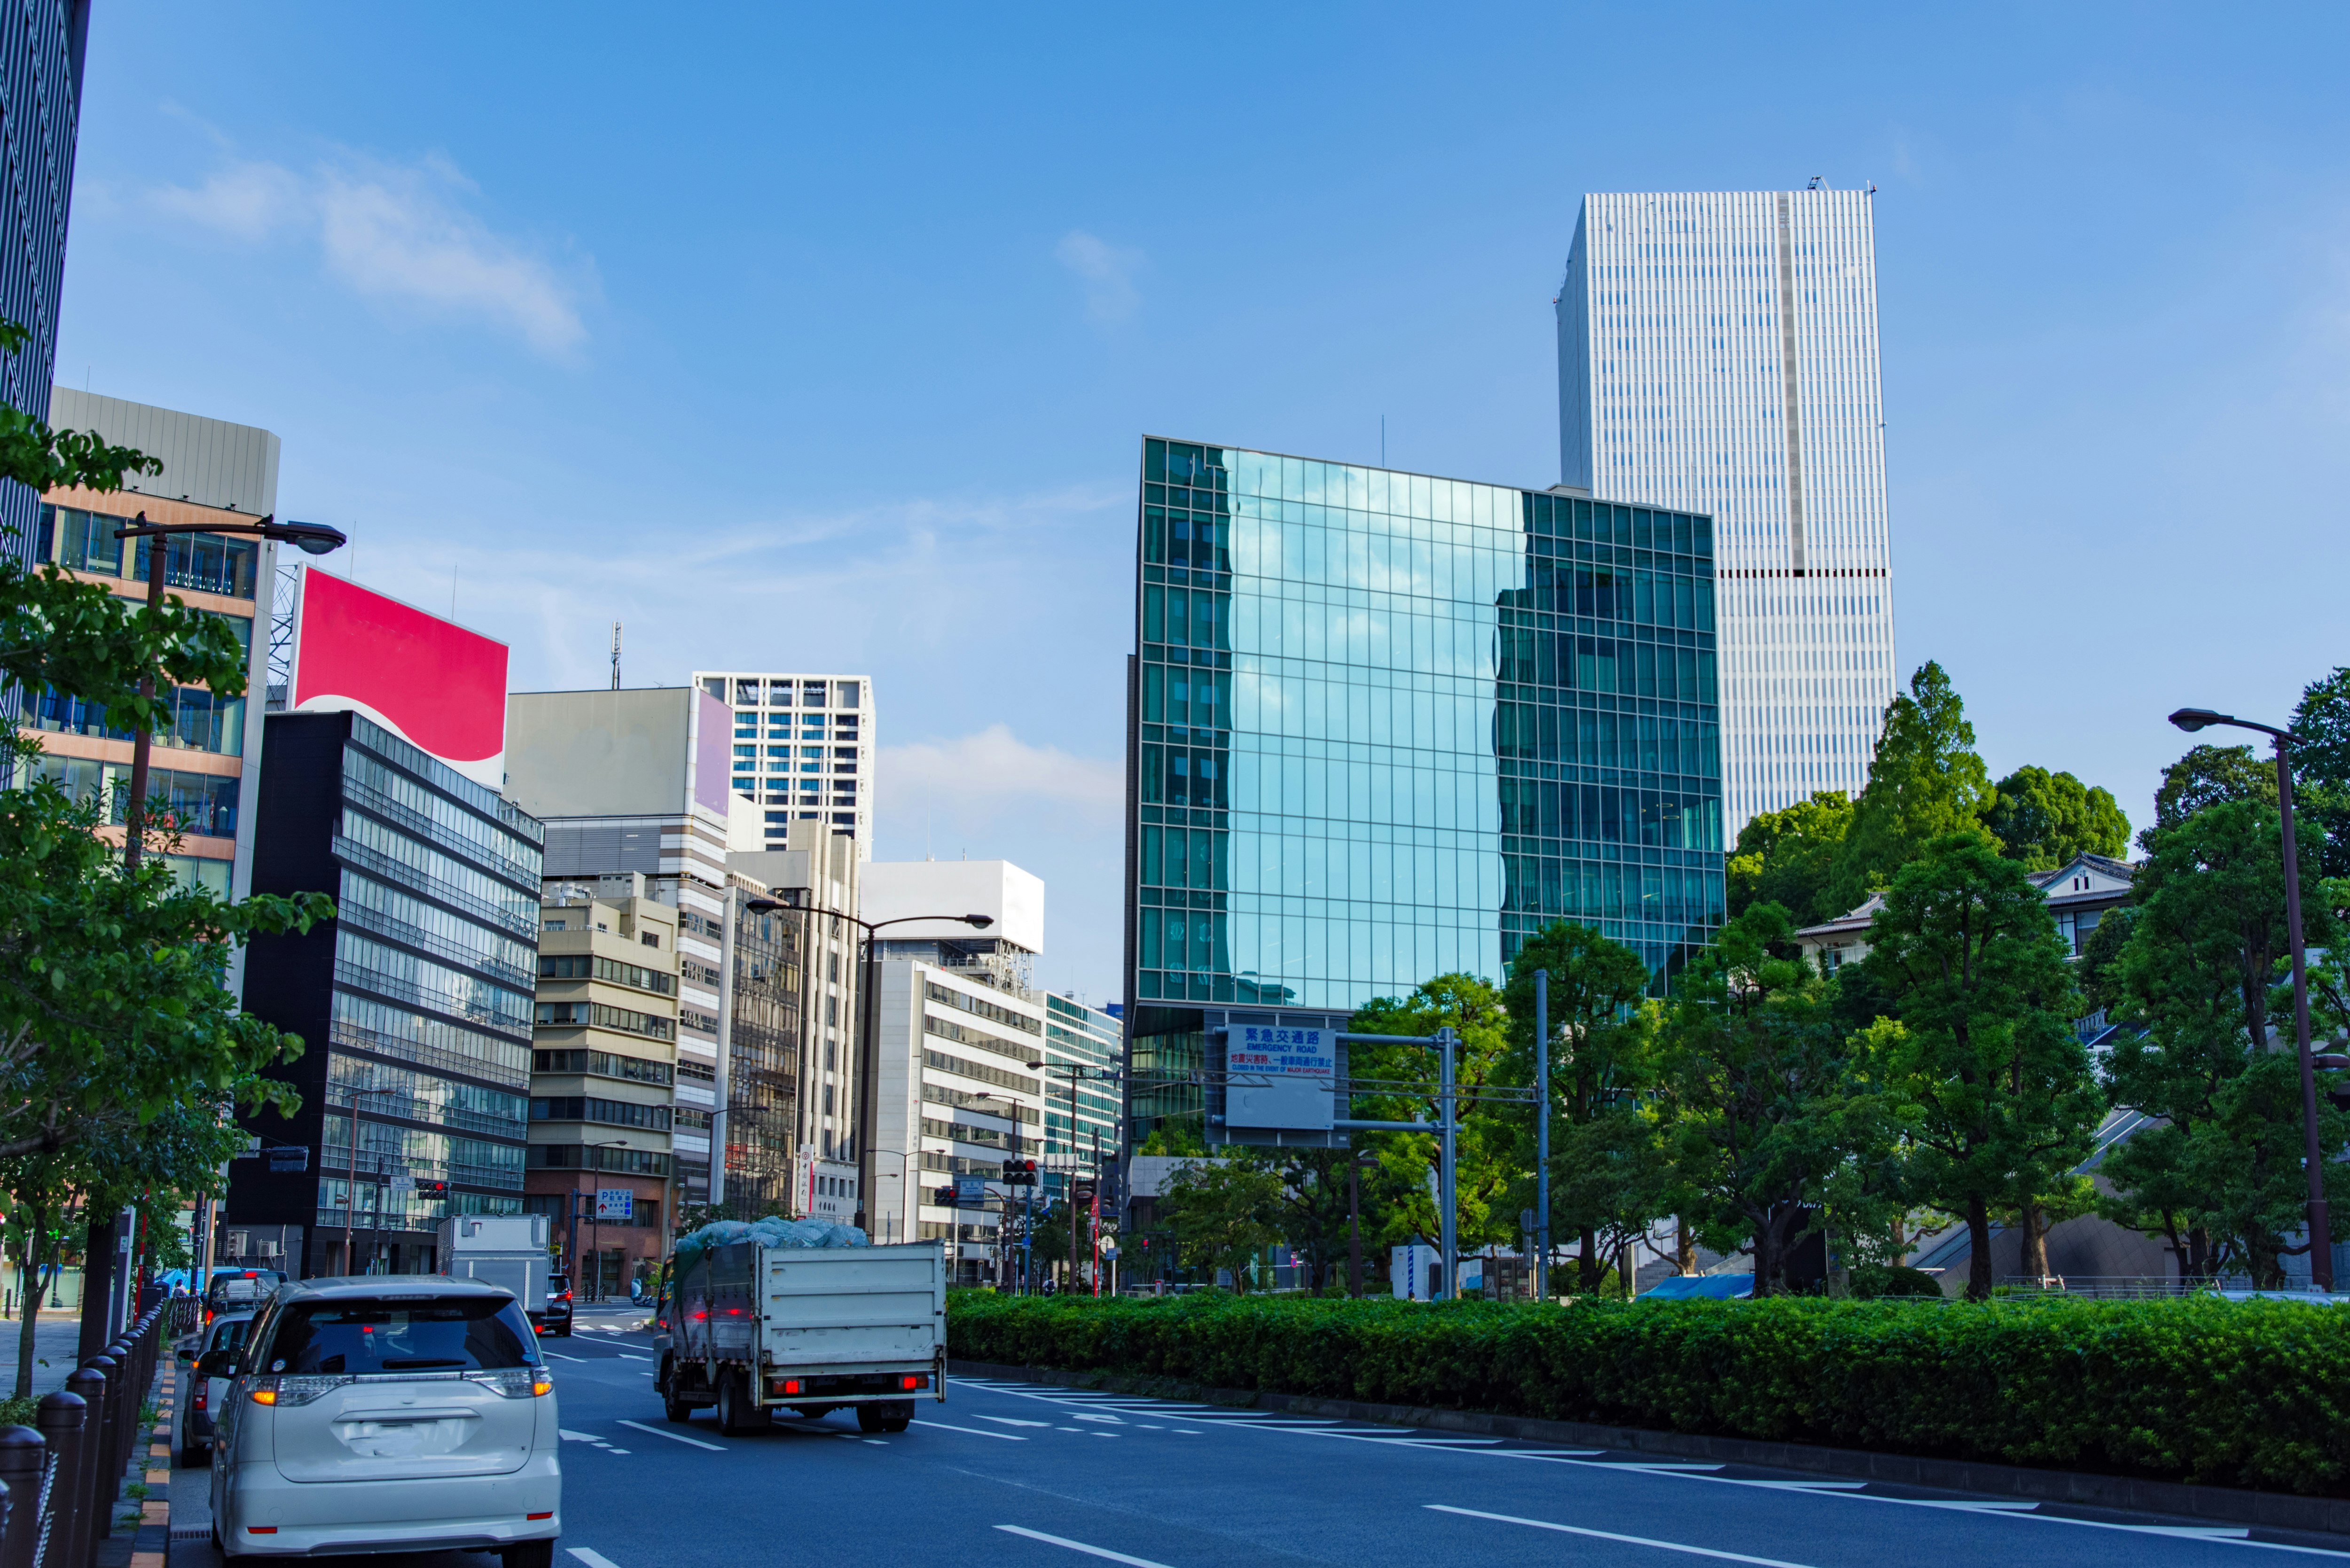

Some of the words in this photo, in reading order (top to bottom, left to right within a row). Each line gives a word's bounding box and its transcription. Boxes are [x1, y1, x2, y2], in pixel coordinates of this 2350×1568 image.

[1246, 1028, 1319, 1045] 緊急交通路
[1247, 1043, 1292, 1053] EMERGENCY
